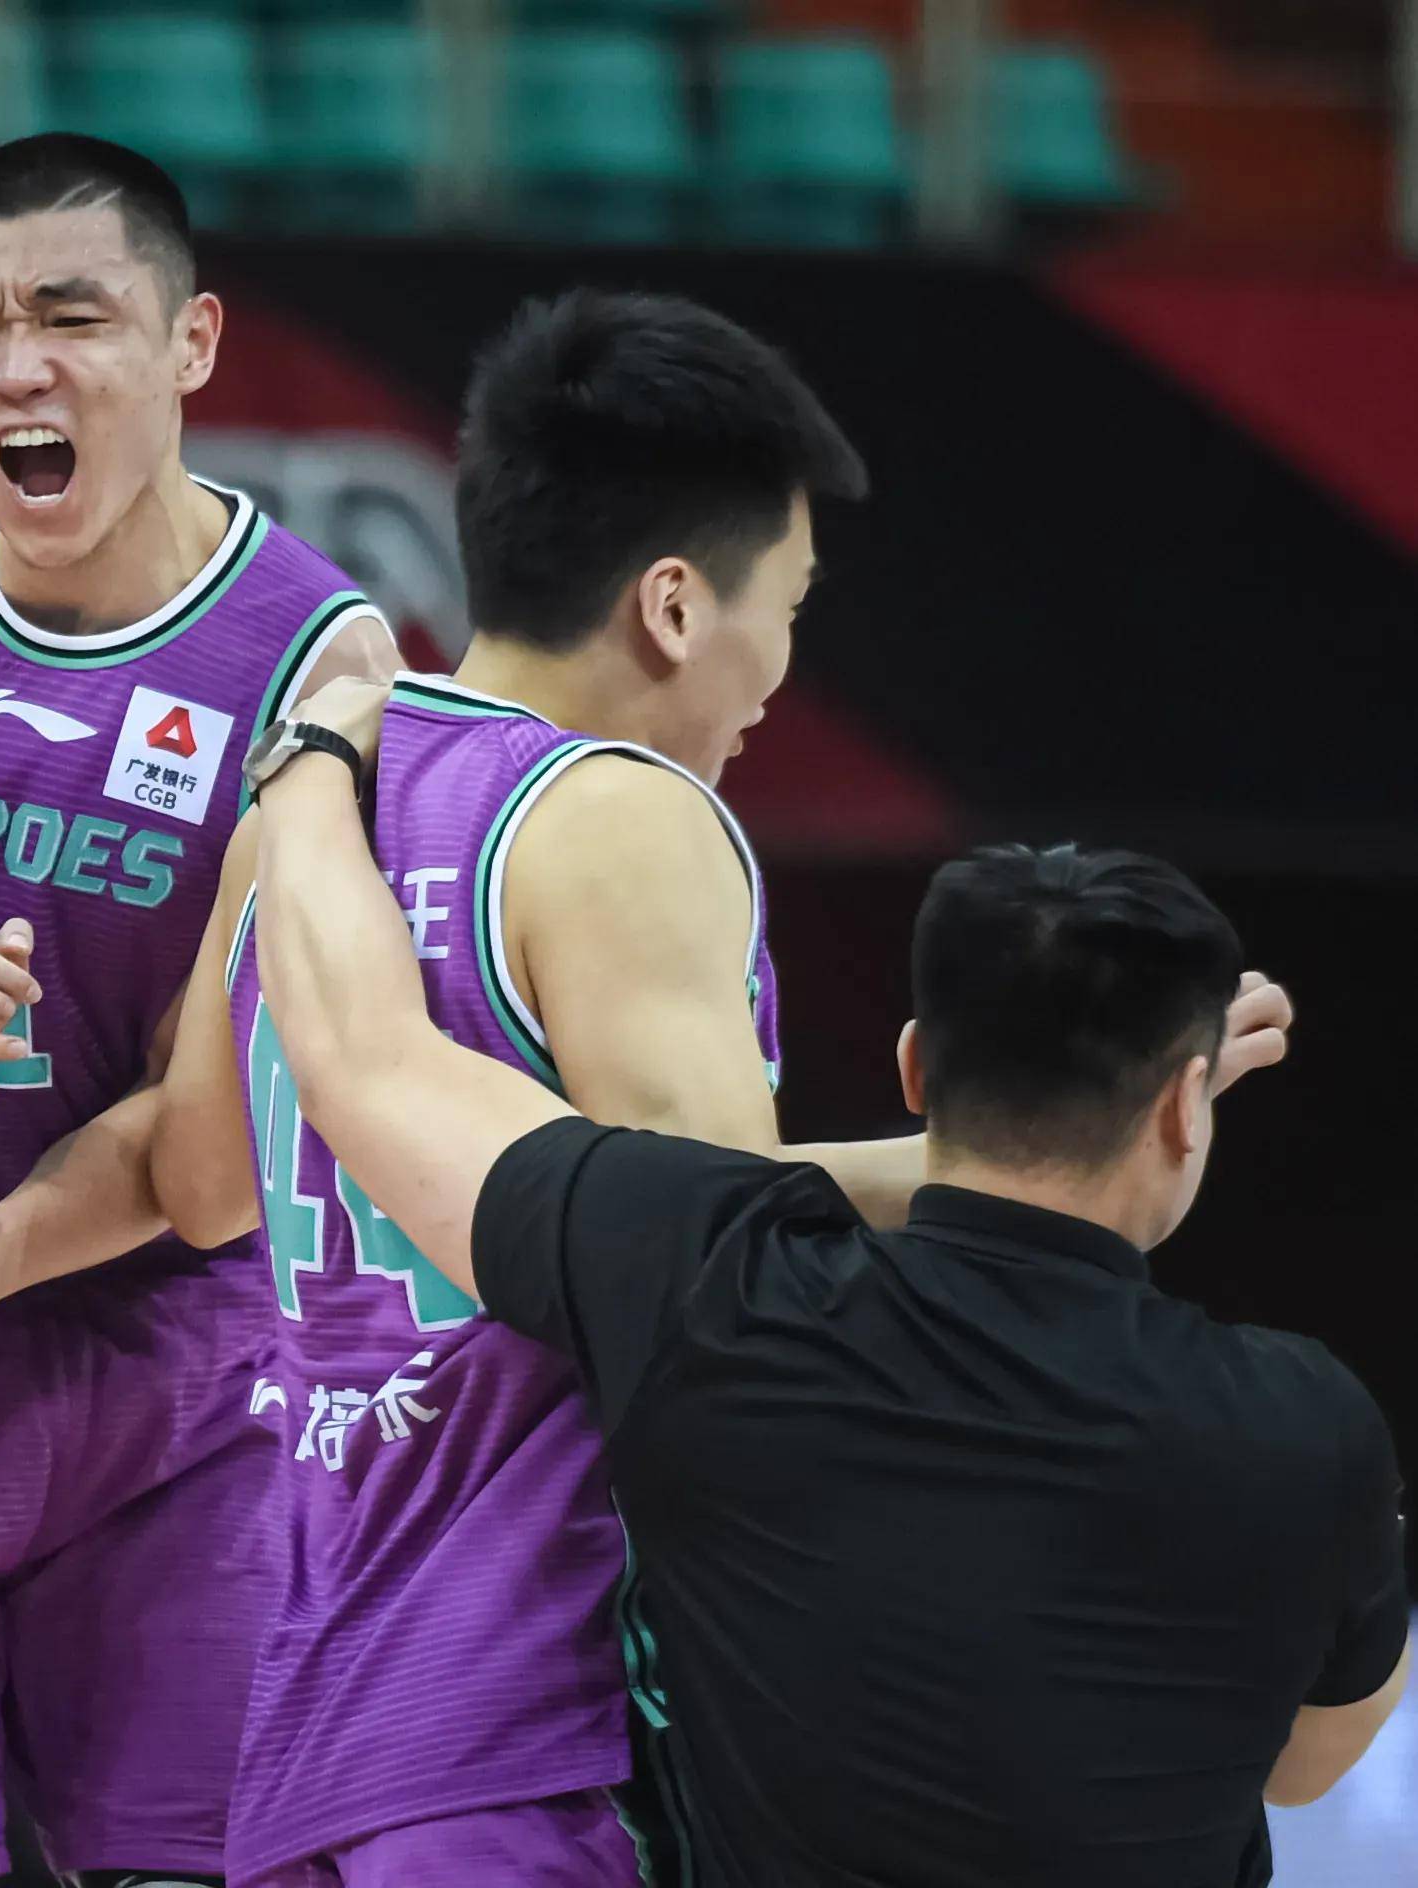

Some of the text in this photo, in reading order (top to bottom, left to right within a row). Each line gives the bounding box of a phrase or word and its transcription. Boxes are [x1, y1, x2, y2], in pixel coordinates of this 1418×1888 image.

[125, 758, 198, 794] 广发银行
[134, 783, 177, 810] CGB
[248, 1350, 442, 1472] 培东
